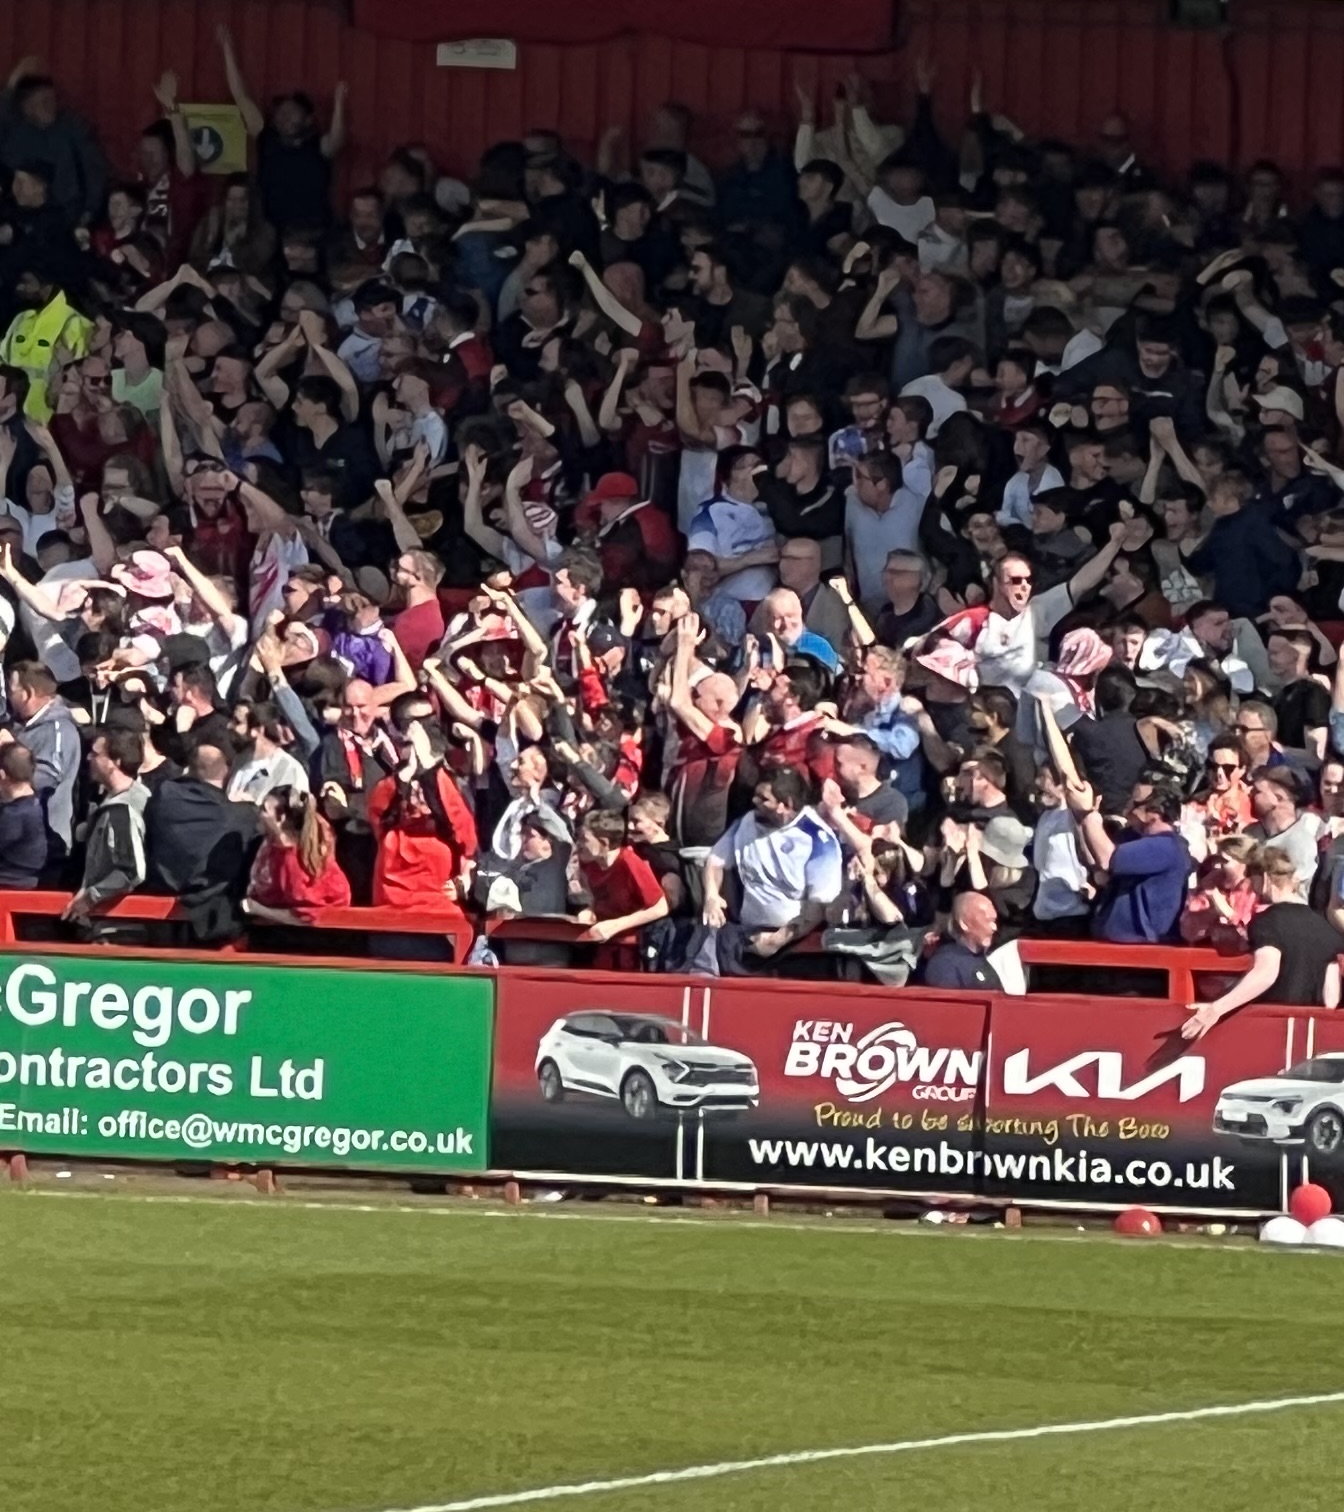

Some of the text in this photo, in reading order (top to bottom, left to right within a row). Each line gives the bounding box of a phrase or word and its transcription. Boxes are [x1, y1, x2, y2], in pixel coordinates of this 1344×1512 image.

[0, 963, 253, 1047] Gregor
[793, 1019, 854, 1044] KEN
[250, 1055, 324, 1100] Ltd
[784, 1041, 983, 1086] BROWN
[0, 1103, 473, 1155] Email: office@wmcgregor.co.uk
[814, 1101, 883, 1129] Proud
[892, 1112, 913, 1130] to
[921, 1108, 948, 1131] be
[1066, 1113, 1110, 1139] The
